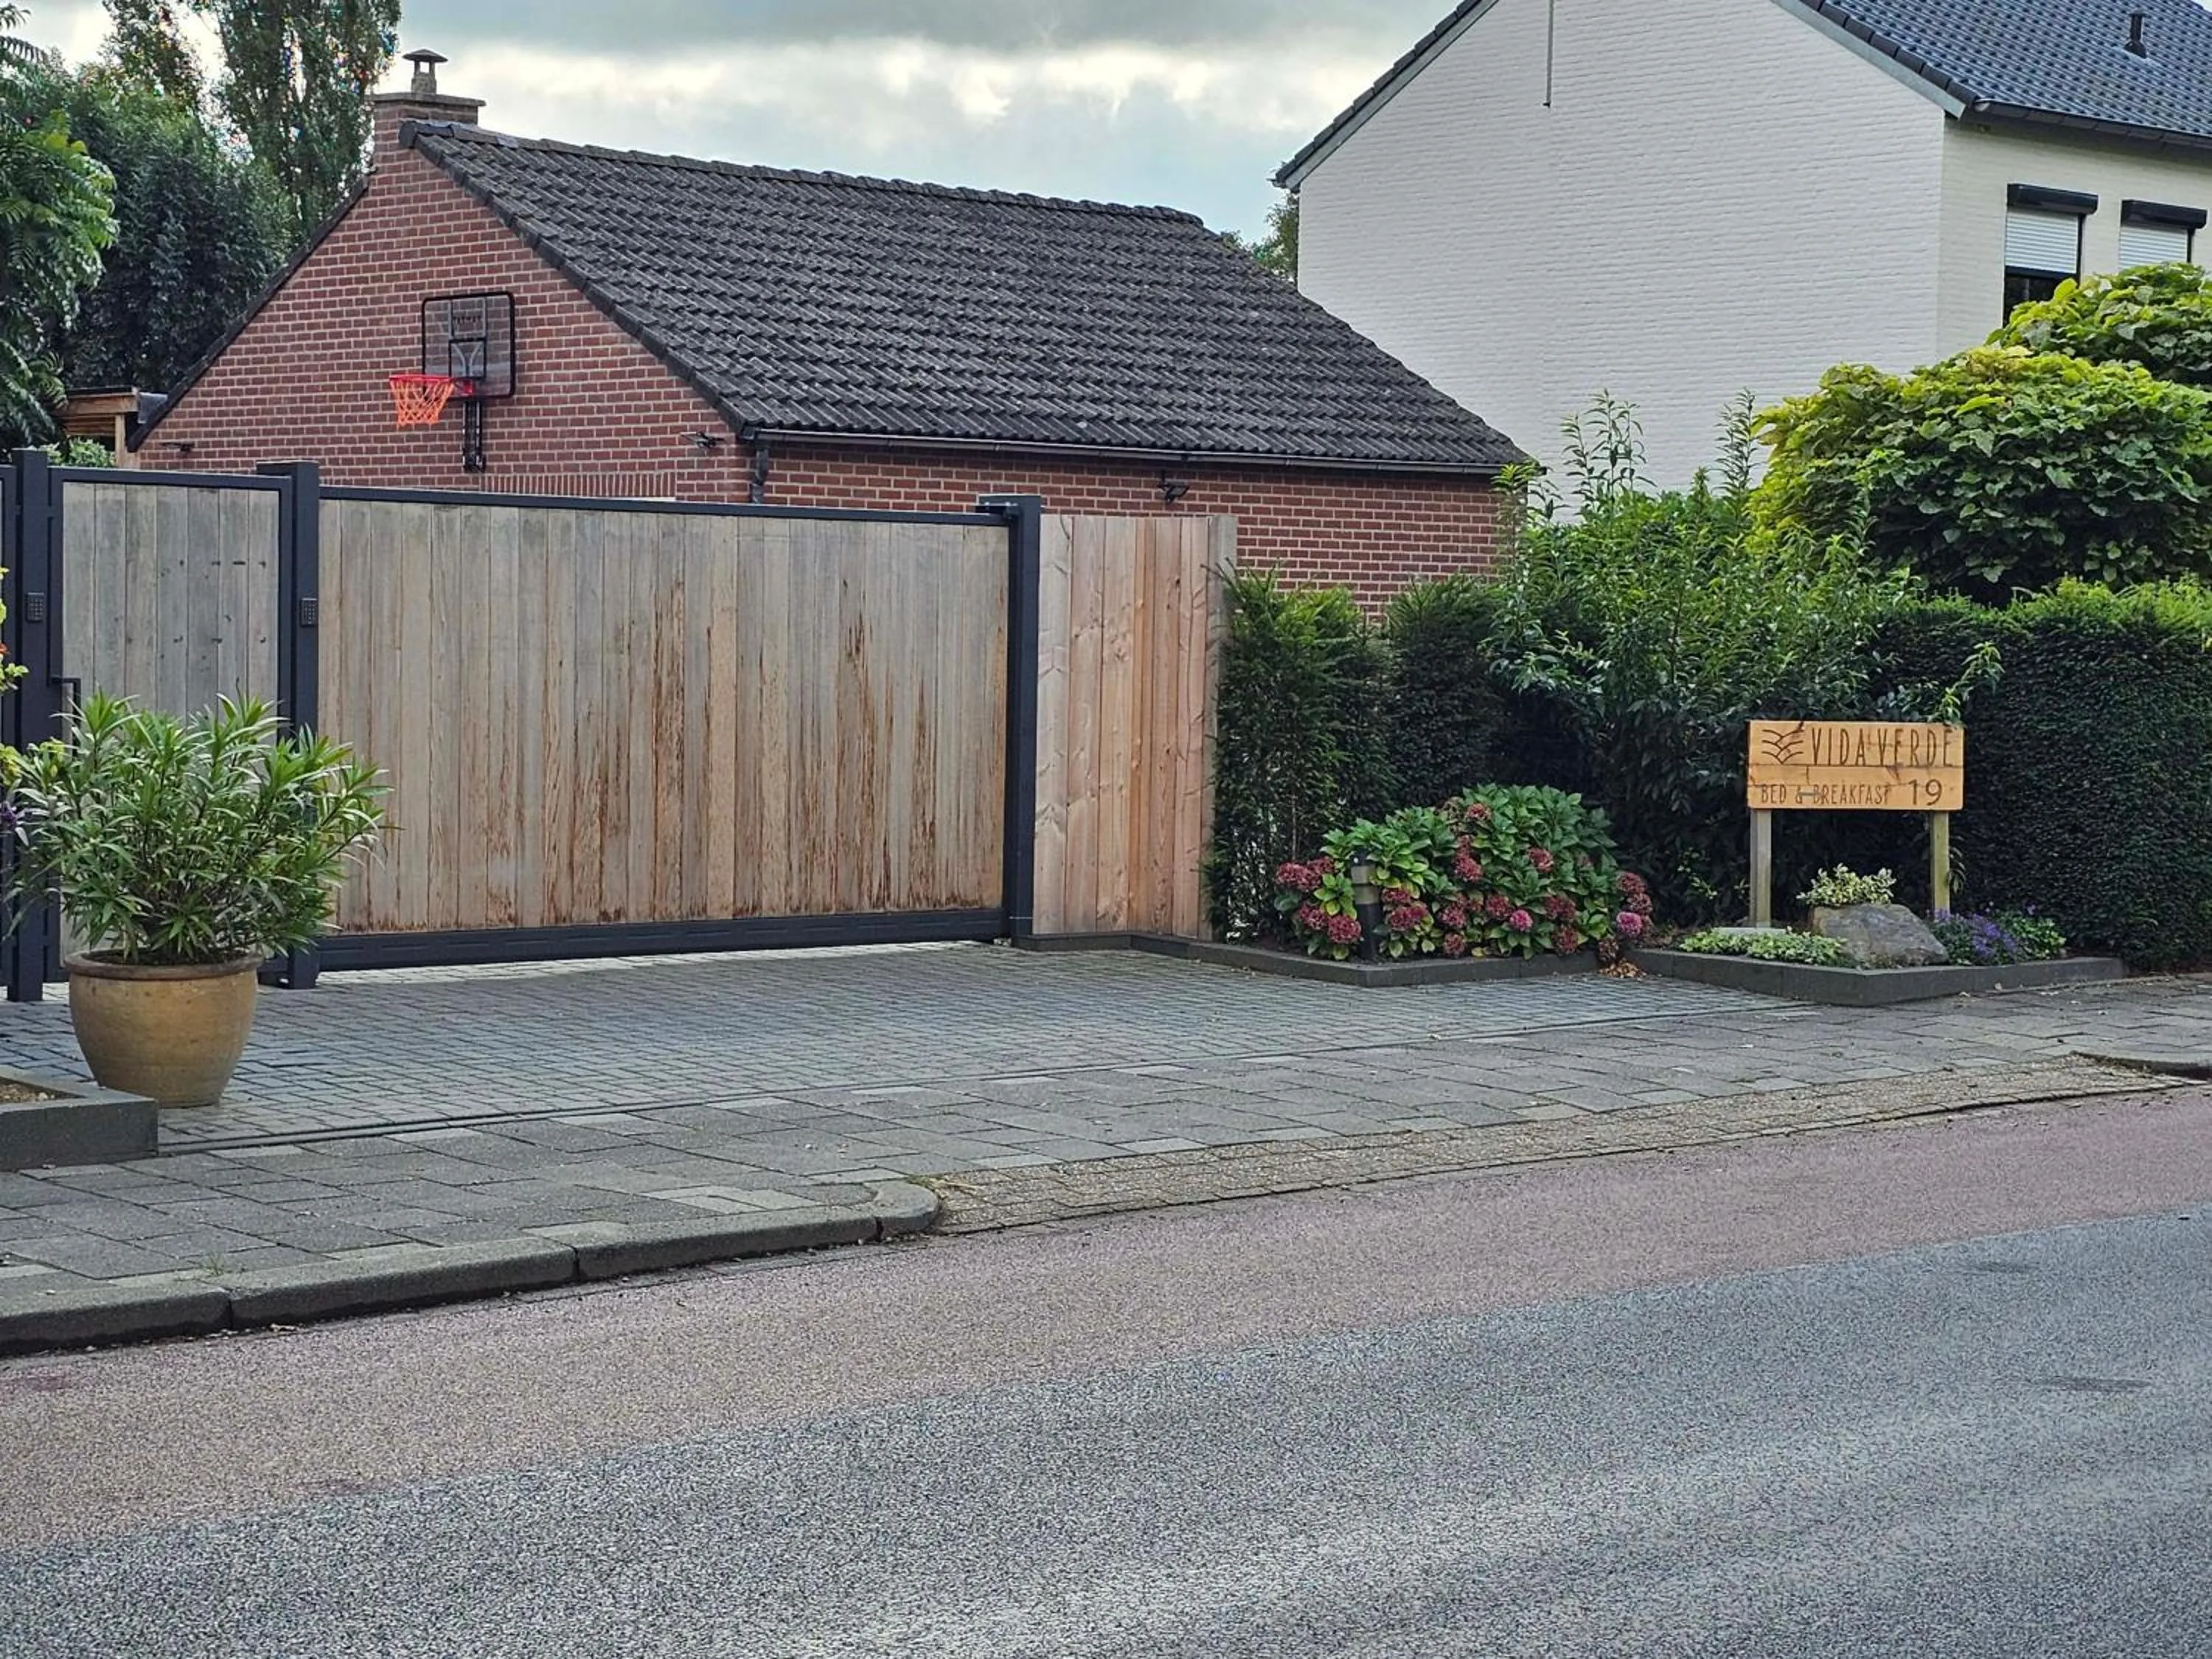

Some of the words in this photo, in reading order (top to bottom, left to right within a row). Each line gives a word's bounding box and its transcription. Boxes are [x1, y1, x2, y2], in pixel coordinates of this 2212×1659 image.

[1811, 727, 1866, 767] VIDA
[1877, 727, 1954, 768] VERDE
[1761, 784, 1787, 804] BED
[1795, 784, 1804, 804] &
[1812, 783, 1891, 805] BREAKFAST
[1908, 778, 1942, 806] 19
